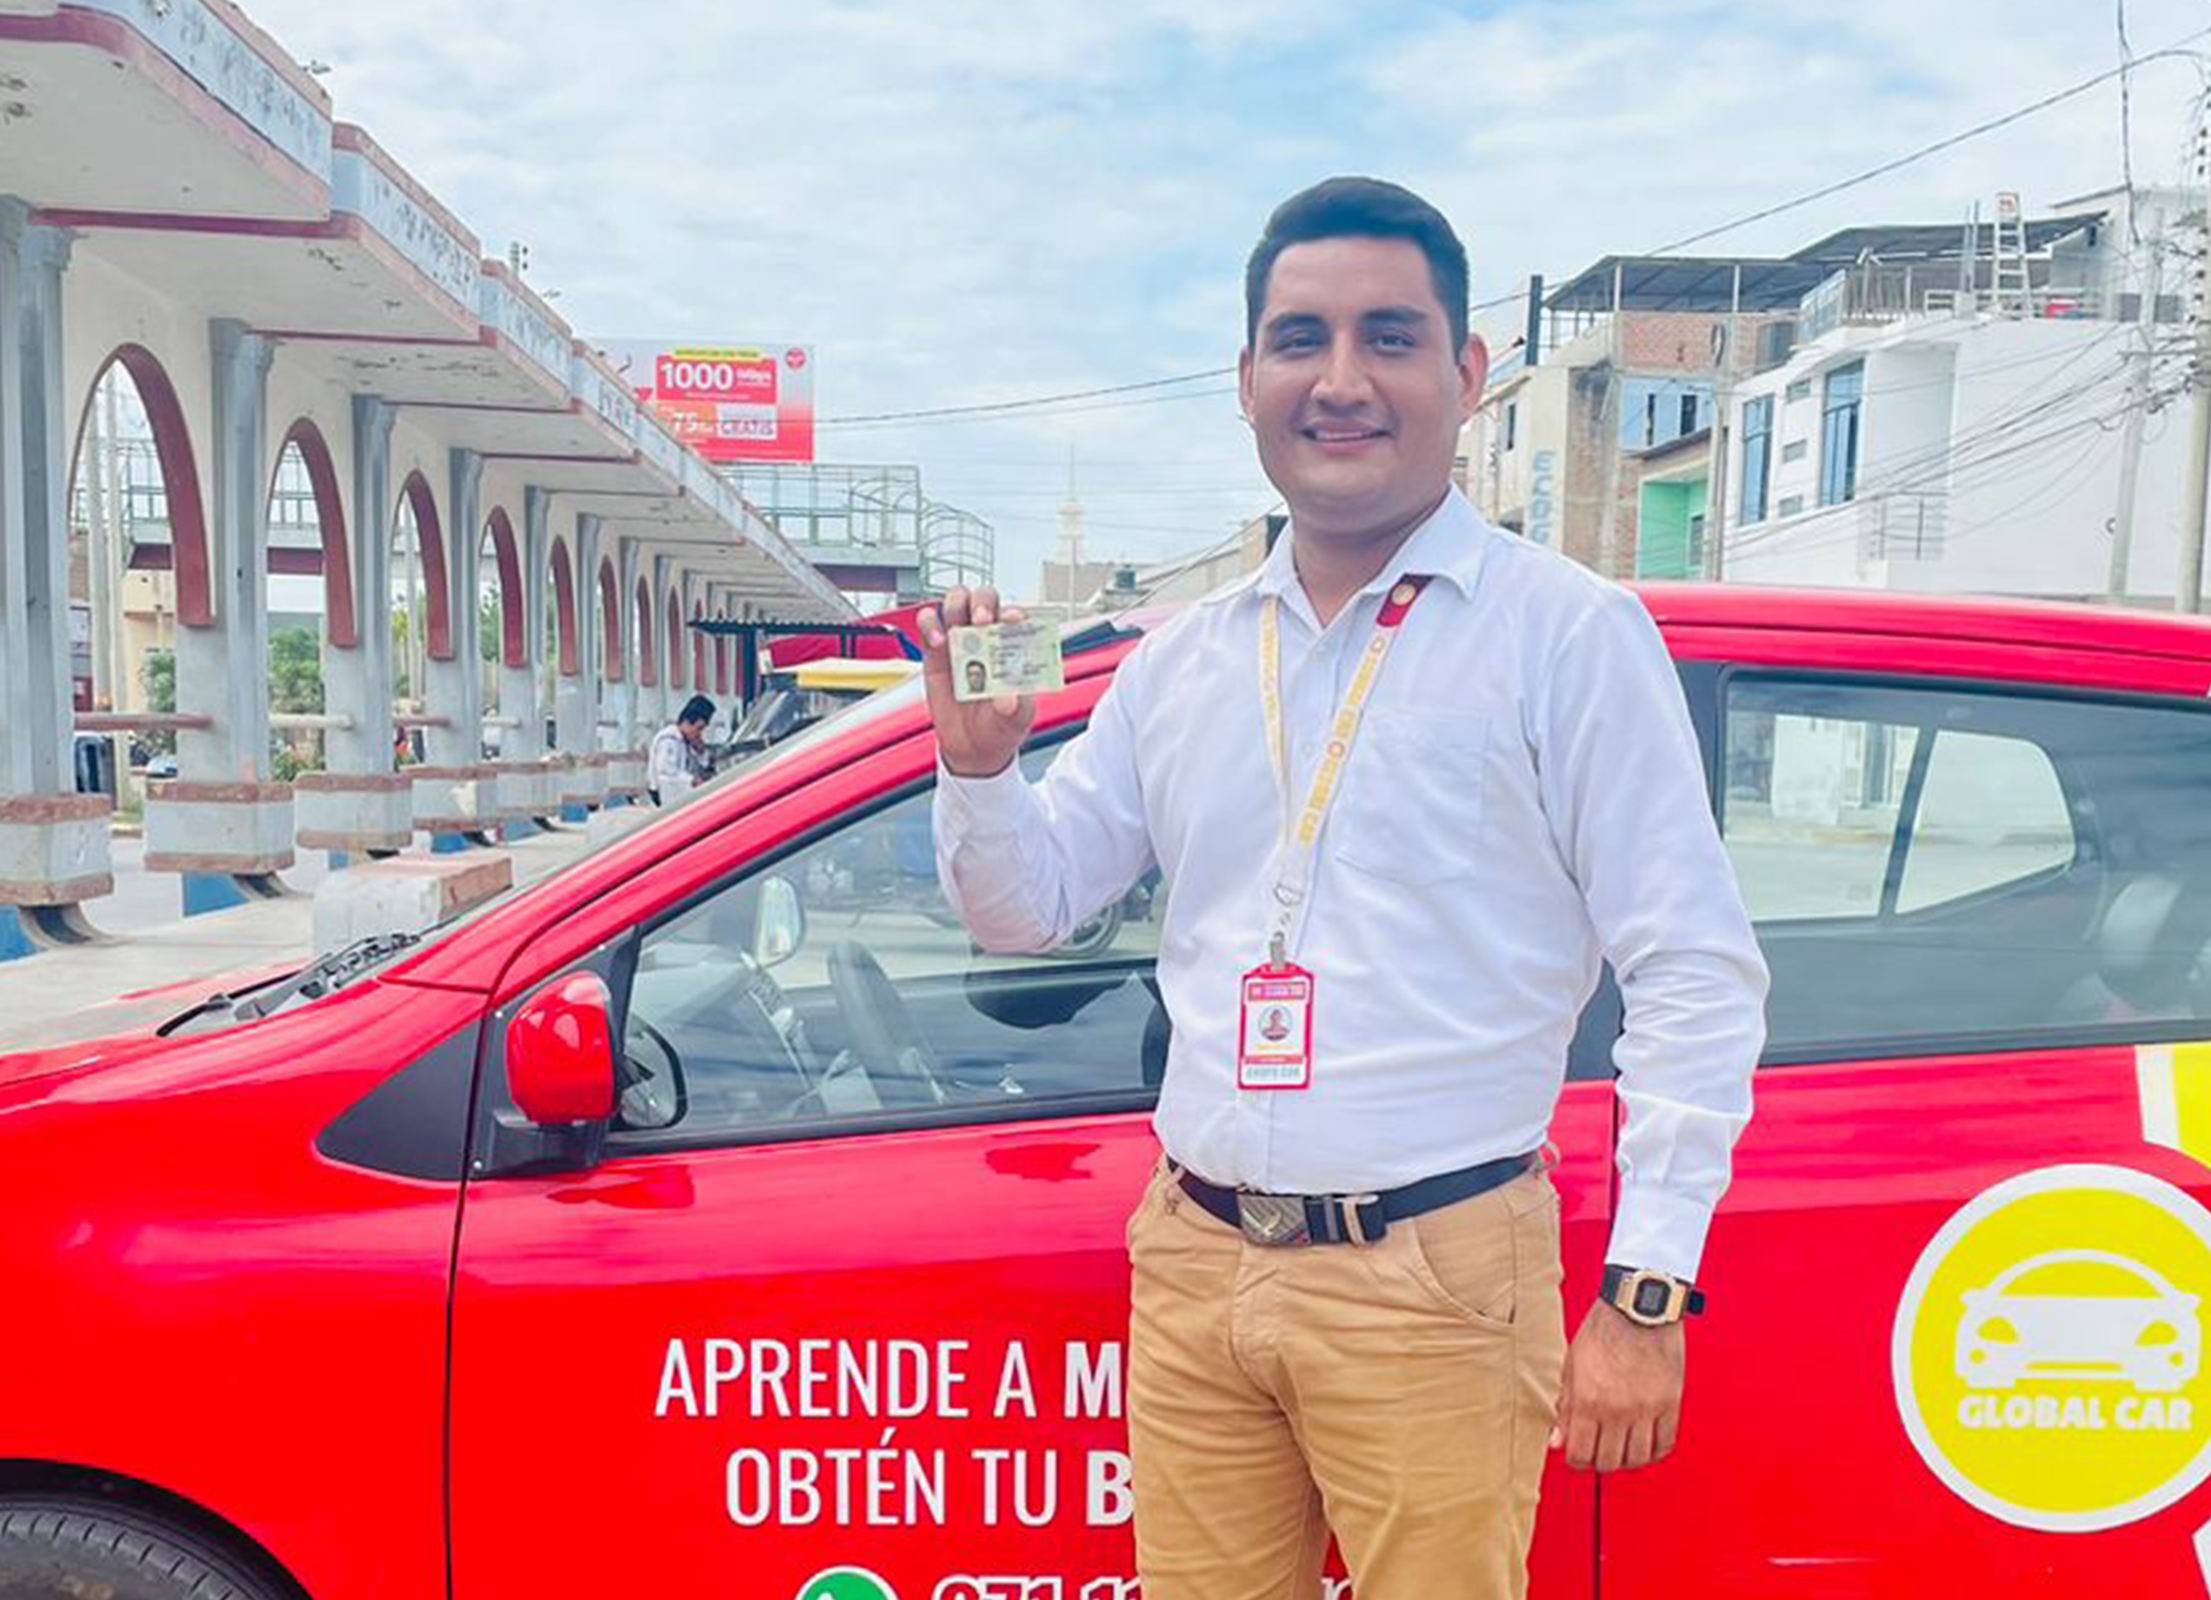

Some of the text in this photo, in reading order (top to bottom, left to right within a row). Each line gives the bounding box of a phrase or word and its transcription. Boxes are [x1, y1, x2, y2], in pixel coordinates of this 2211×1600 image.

[660, 362, 733, 391] 1000
[655, 1339, 969, 1418] APRENDE
[993, 1341, 1037, 1418] A
[1958, 1395, 2193, 1431] GLOBAL CAR
[726, 1427, 945, 1526] OBTÉN
[971, 1449, 1057, 1526] TU
